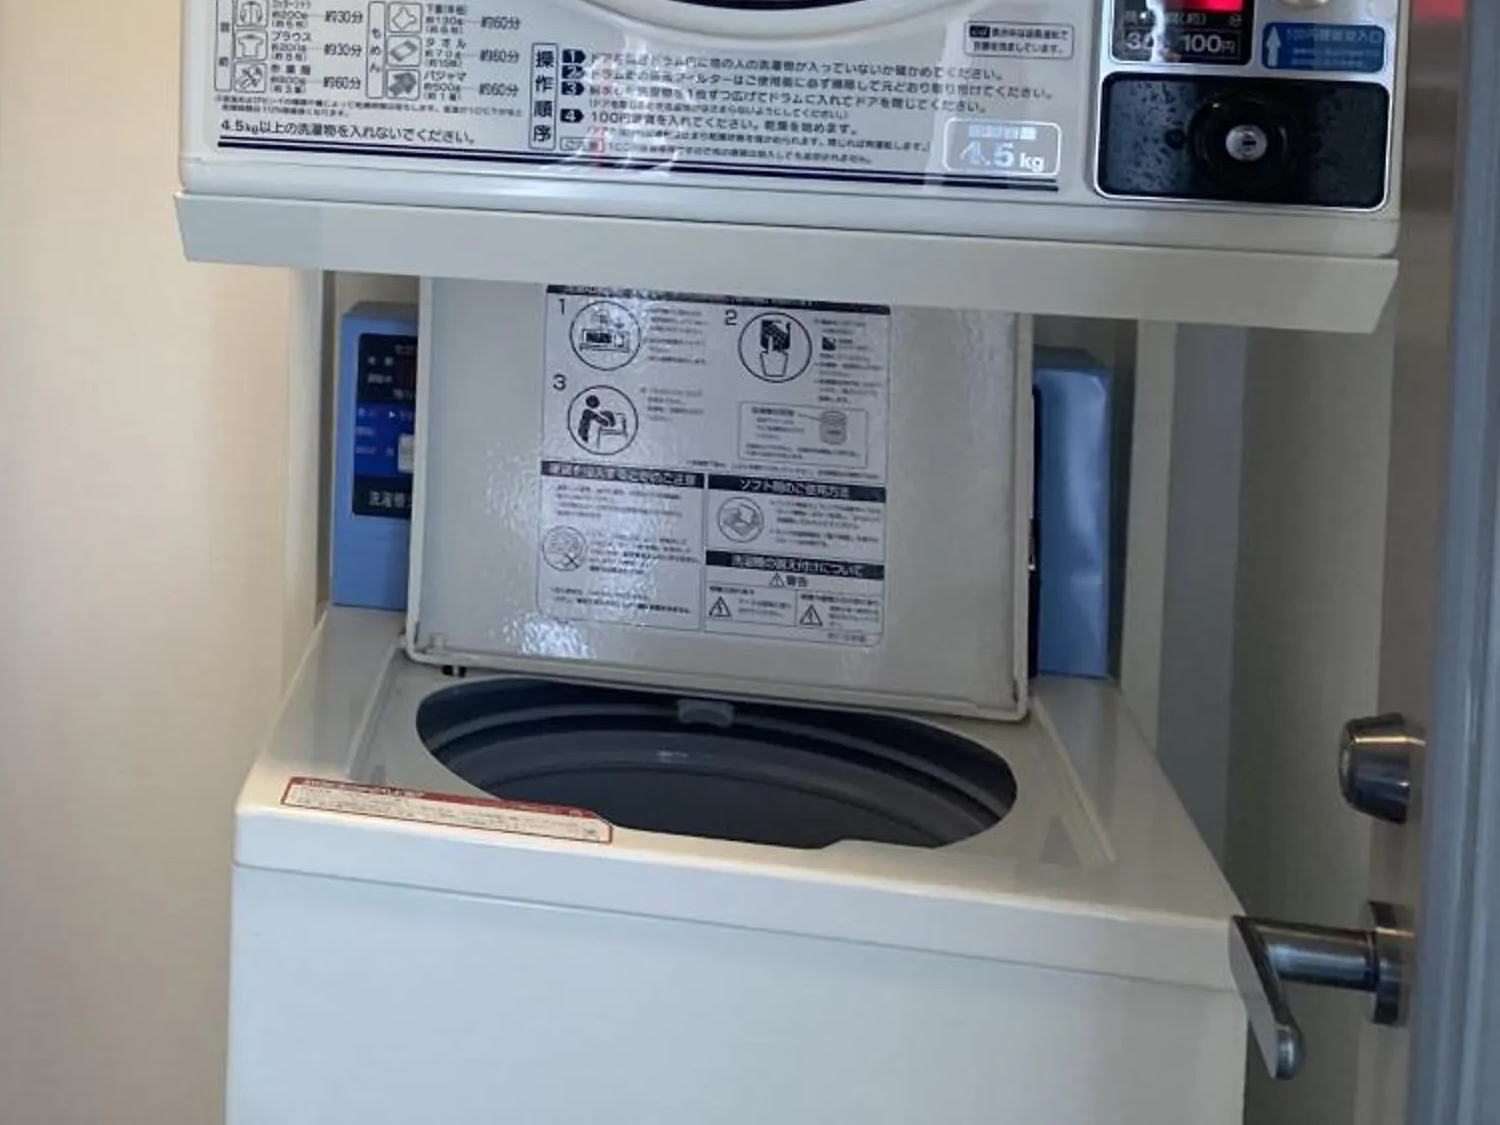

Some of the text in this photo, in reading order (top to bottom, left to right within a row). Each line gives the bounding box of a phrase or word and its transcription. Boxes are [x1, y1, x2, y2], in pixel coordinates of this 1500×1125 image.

[325, 10, 363, 24] 約30分
[272, 31, 311, 41] ブラウス
[324, 43, 362, 57] 約30分
[533, 50, 555, 143] 操作順序
[1019, 153, 1045, 173] kg
[558, 298, 566, 316] 1
[724, 309, 738, 325] 2
[553, 373, 567, 391] 3
